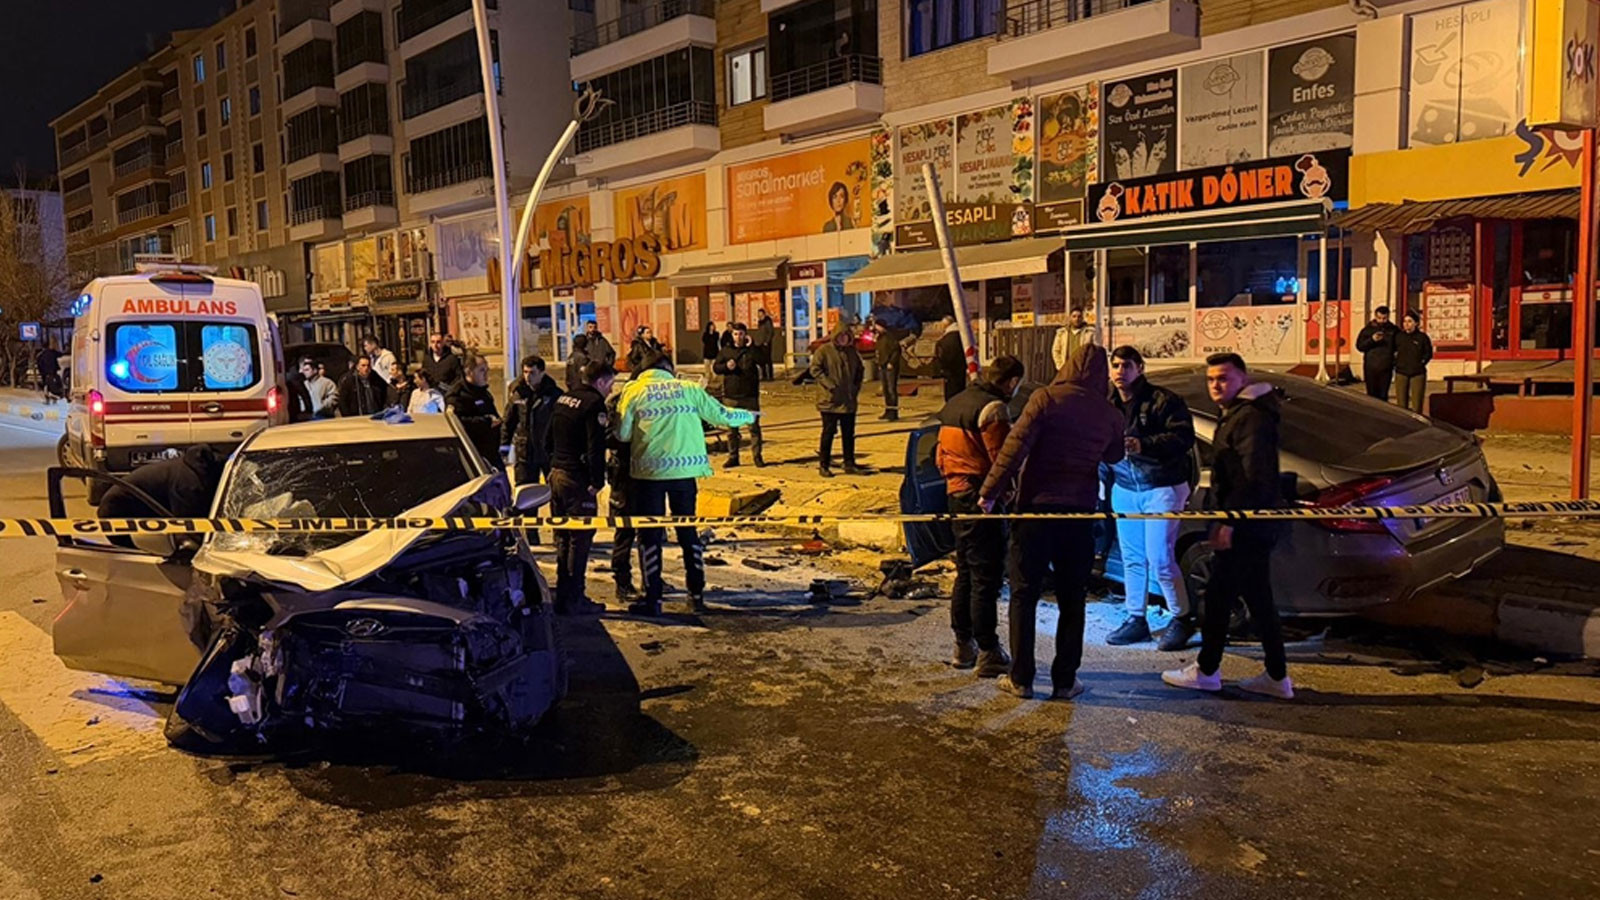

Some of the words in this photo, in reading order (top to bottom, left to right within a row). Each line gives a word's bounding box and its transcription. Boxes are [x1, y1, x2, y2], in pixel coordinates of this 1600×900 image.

[1435, 9, 1491, 31] HESAPLI
[1293, 84, 1335, 103] Enfes
[1233, 104, 1259, 115] Lezzet
[1125, 178, 1194, 215] KATIK
[1202, 166, 1293, 206] DÖNER
[946, 205, 996, 226] ESAPLI
[122, 299, 238, 316] AMBULANS
